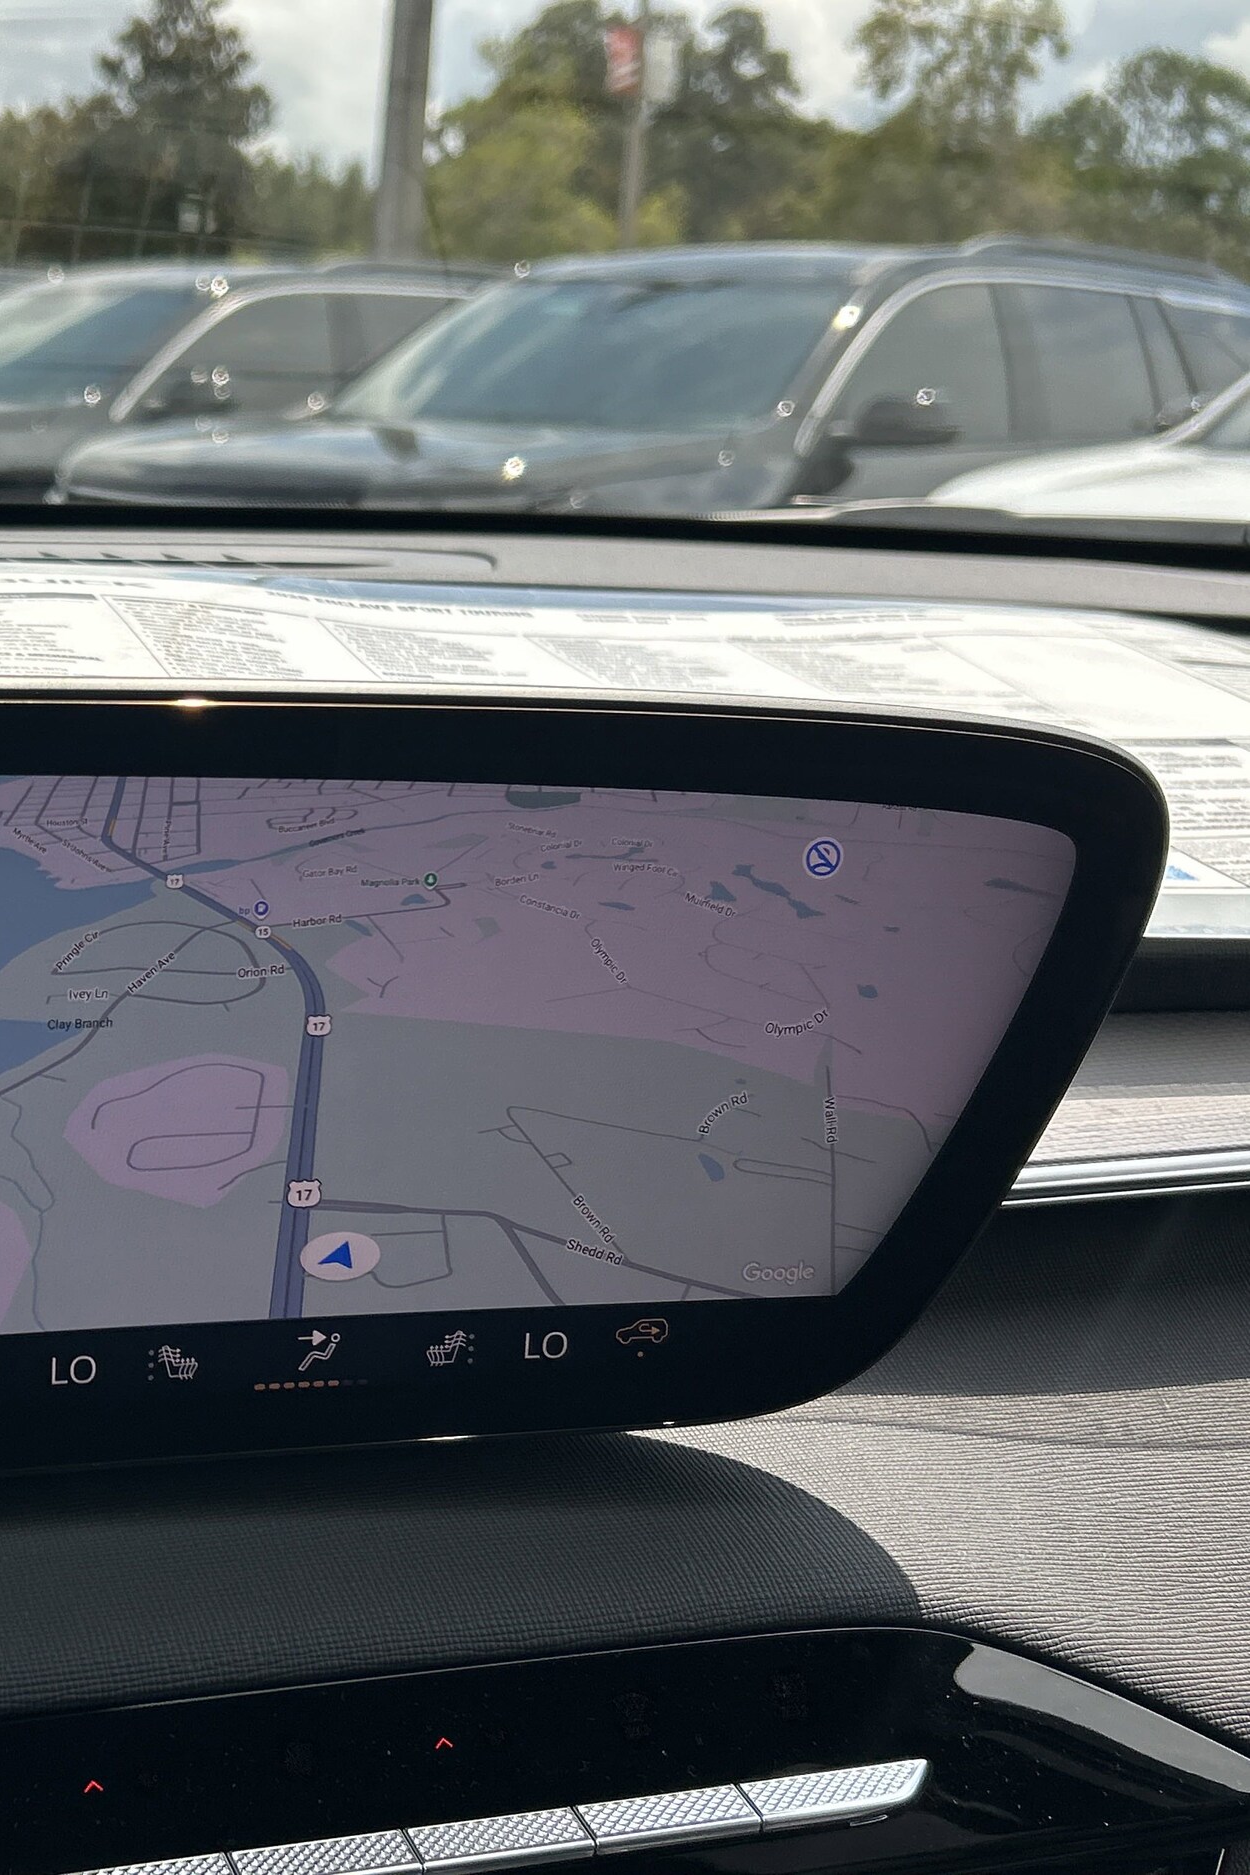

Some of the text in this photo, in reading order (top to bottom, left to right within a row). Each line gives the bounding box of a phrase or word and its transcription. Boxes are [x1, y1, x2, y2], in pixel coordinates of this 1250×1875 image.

[302, 865, 357, 879] Gator Bay Rd
[360, 876, 420, 889] Magnolia Park
[495, 873, 539, 887] Borden Ln
[239, 906, 250, 917] bp
[519, 894, 581, 920] Constancia Dr
[685, 892, 736, 918] Muirfield Dr
[258, 927, 268, 936] 15
[293, 914, 342, 927] Harbor Rd
[55, 930, 99, 971] Pringle Cir
[590, 938, 628, 984] Olympic Dr
[127, 951, 175, 994] Haven Ave
[237, 965, 285, 977] Orion Rd
[69, 989, 108, 1001] Ivey Ln
[47, 1017, 113, 1031] Clay Branch
[312, 1022, 326, 1032] 17
[764, 1007, 829, 1038] Olympic Dr
[698, 1091, 749, 1135] Brown Rd
[824, 1097, 838, 1143] Wall Rd
[296, 1189, 313, 1201] 17
[572, 1195, 614, 1244] Brown Rd
[566, 1239, 623, 1266] Shedd Rd
[742, 1261, 815, 1284] Google
[524, 1331, 568, 1359] LO
[51, 1355, 97, 1385] LO
